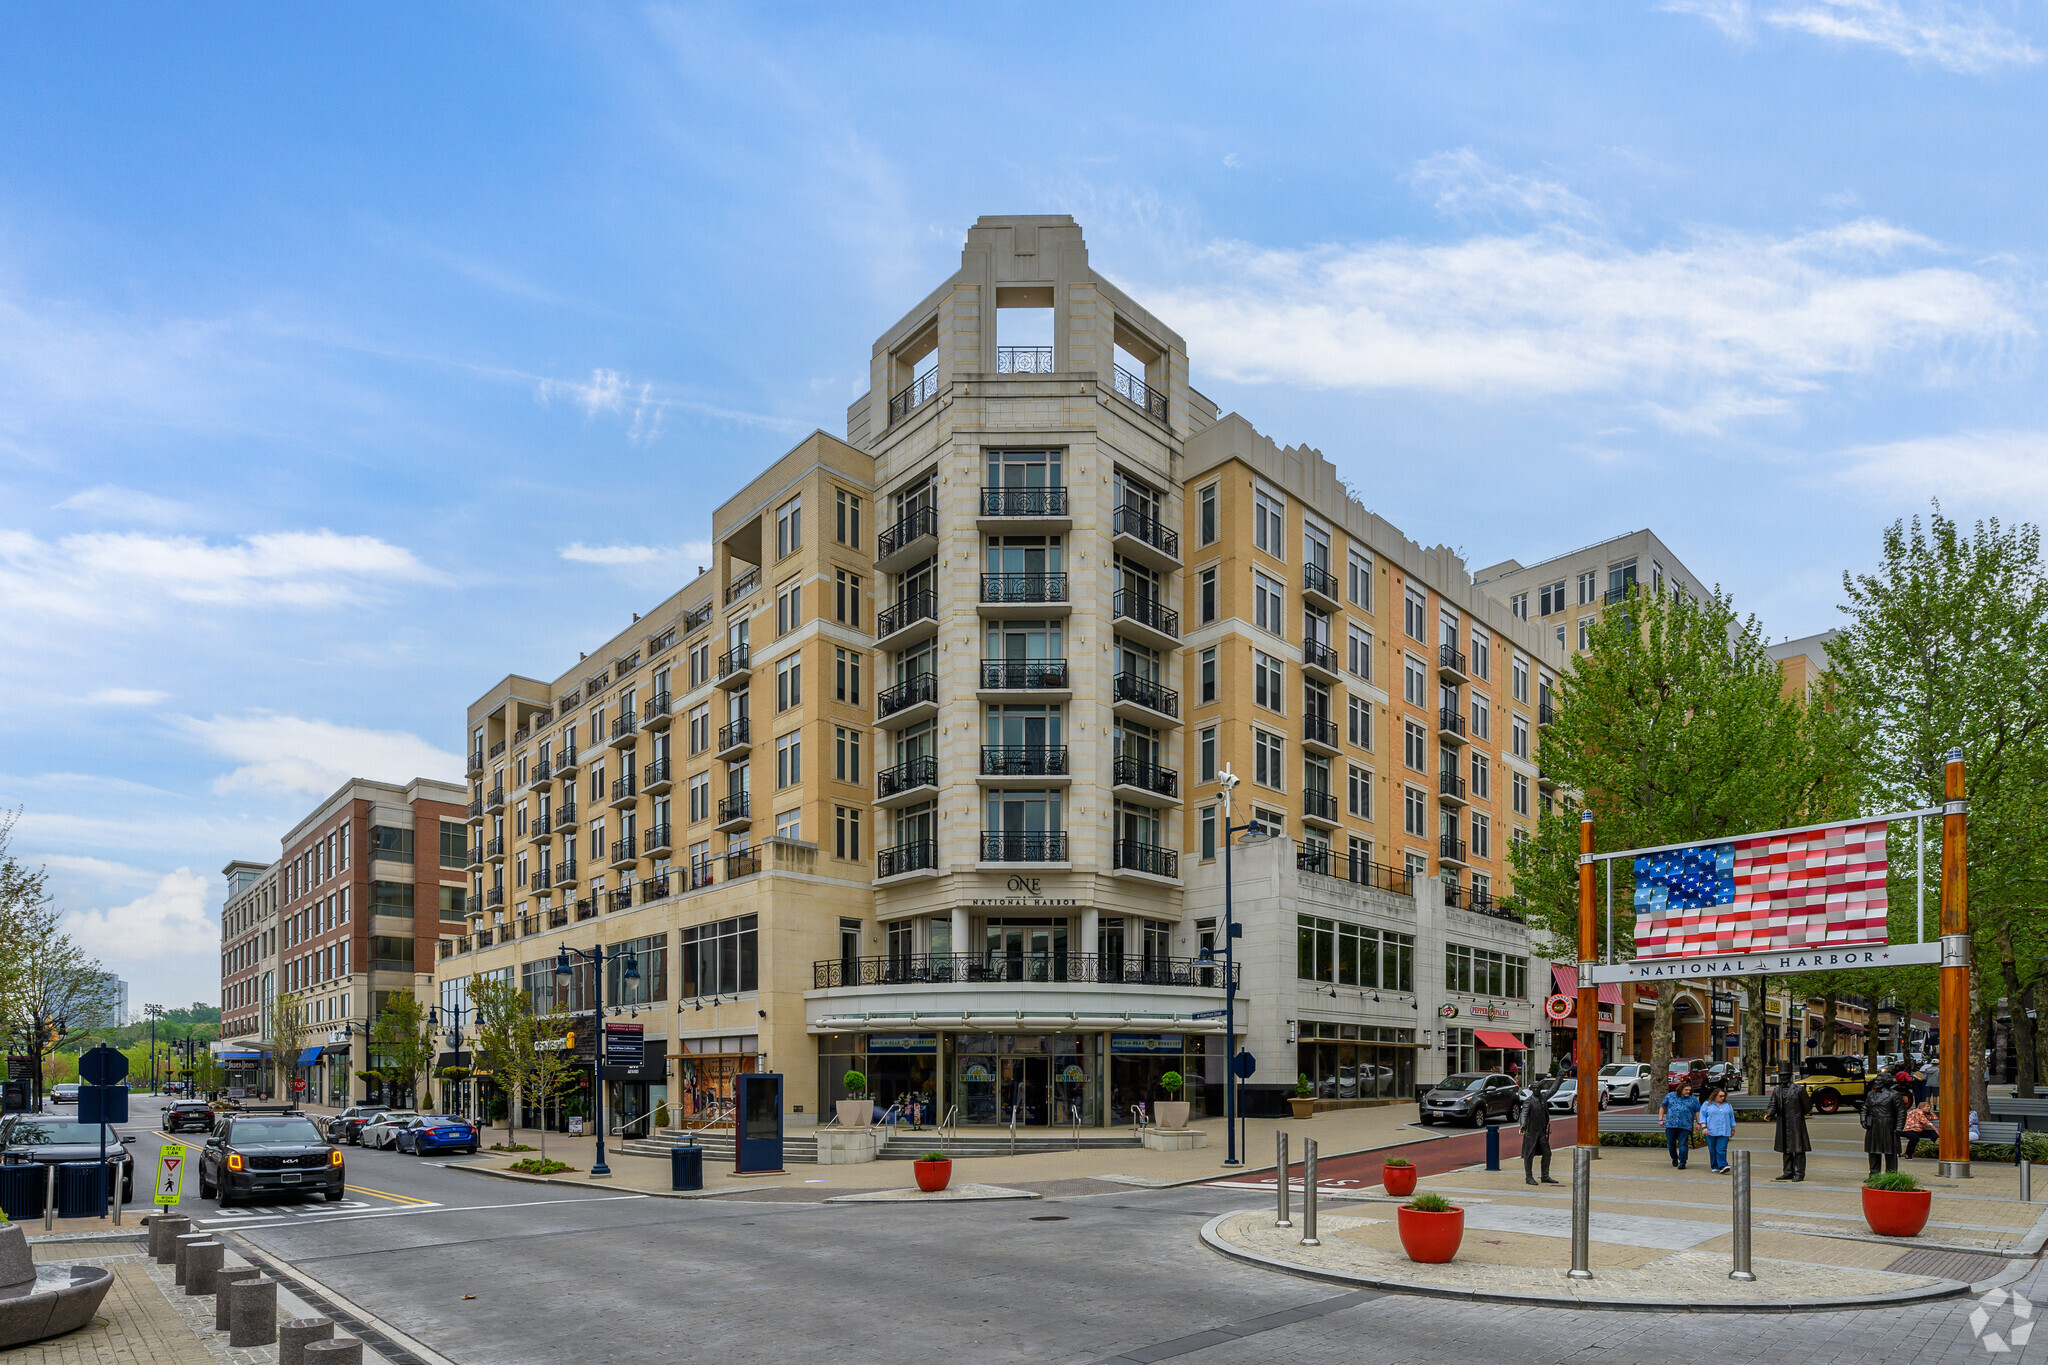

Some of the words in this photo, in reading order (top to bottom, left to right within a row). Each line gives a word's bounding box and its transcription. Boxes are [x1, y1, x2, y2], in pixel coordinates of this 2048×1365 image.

[1007, 874, 1042, 895] ONE
[1640, 960, 1745, 977] NATIONAL
[1780, 952, 1874, 967] HARBOR
[1471, 1006, 1488, 1015] PEPPER
[1495, 1008, 1509, 1017] PALACE
